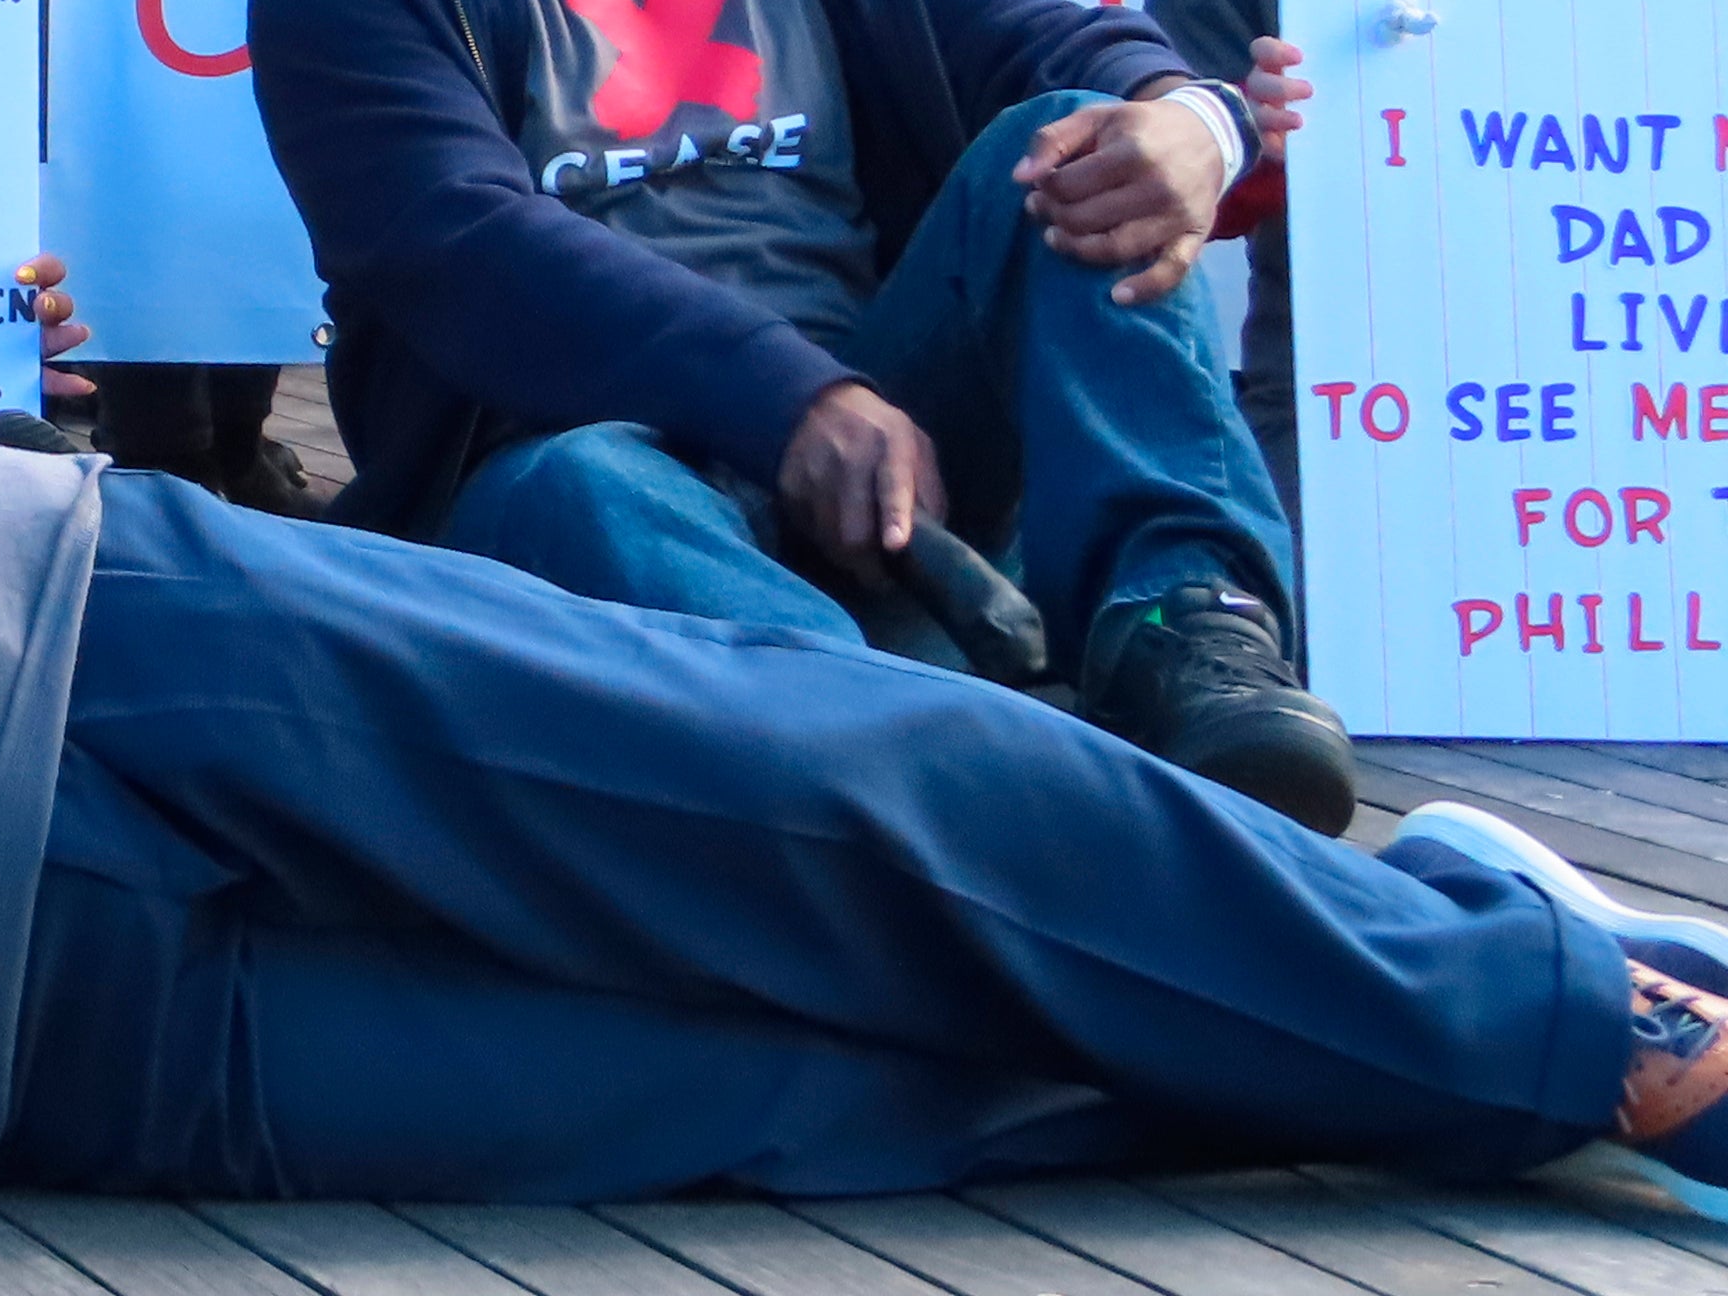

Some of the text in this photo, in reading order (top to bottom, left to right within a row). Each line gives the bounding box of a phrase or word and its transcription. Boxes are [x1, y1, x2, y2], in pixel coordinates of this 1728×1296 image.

[1380, 108, 1407, 167] I
[1459, 109, 1680, 173] WANT
[1551, 204, 1710, 266] DAD
[1570, 292, 1728, 353] LIV
[1312, 381, 1410, 443] TO
[1446, 381, 1576, 442] SEE
[1513, 487, 1671, 548] FOR
[1451, 591, 1720, 657] PHILL
